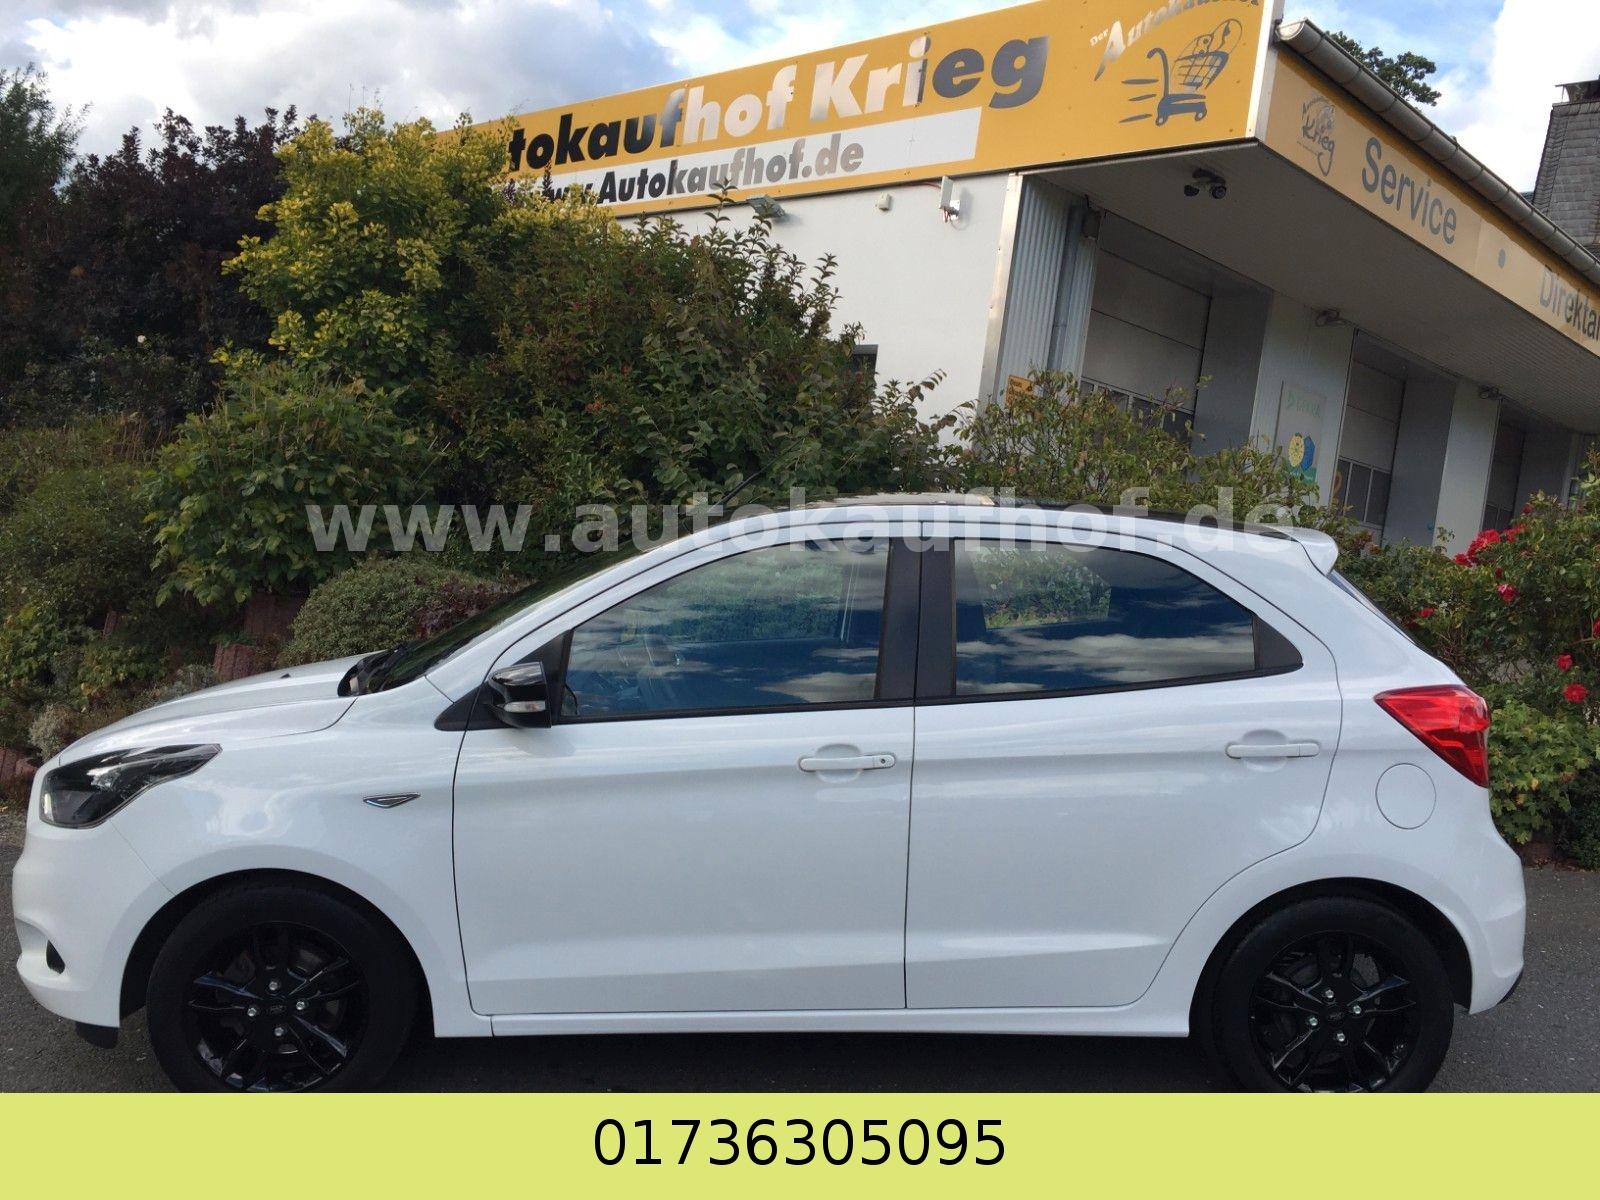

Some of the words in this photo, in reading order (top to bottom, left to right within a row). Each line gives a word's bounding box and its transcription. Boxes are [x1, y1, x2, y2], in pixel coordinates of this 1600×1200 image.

[507, 66, 797, 171] tokaufhof
[809, 35, 1050, 123] Krieg
[1361, 136, 1457, 244] Service
